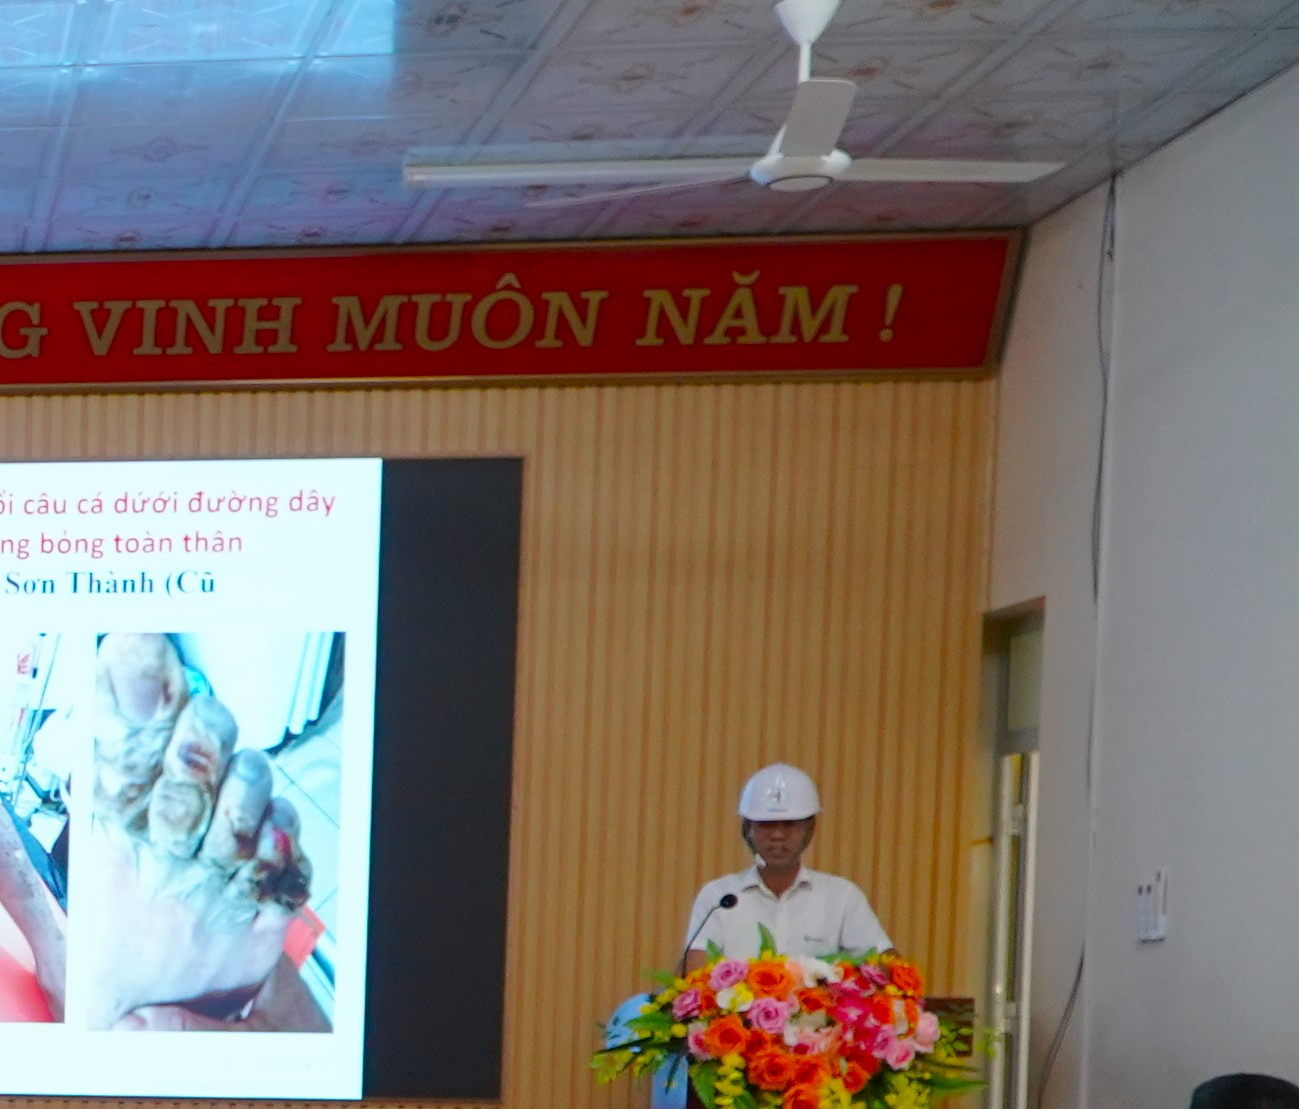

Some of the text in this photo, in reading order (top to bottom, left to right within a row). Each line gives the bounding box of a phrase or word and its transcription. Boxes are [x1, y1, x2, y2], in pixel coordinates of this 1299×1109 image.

[73, 297, 302, 356] VINH
[326, 272, 607, 353] MUÔN
[635, 270, 859, 347] NĂM
[23, 492, 67, 515] câu
[77, 491, 103, 514] cá
[188, 490, 279, 518] đường
[288, 489, 335, 517] dây
[40, 531, 104, 559] bỏng
[113, 531, 172, 554] toàn
[183, 530, 242, 553] thân
[4, 571, 55, 595] Sơn
